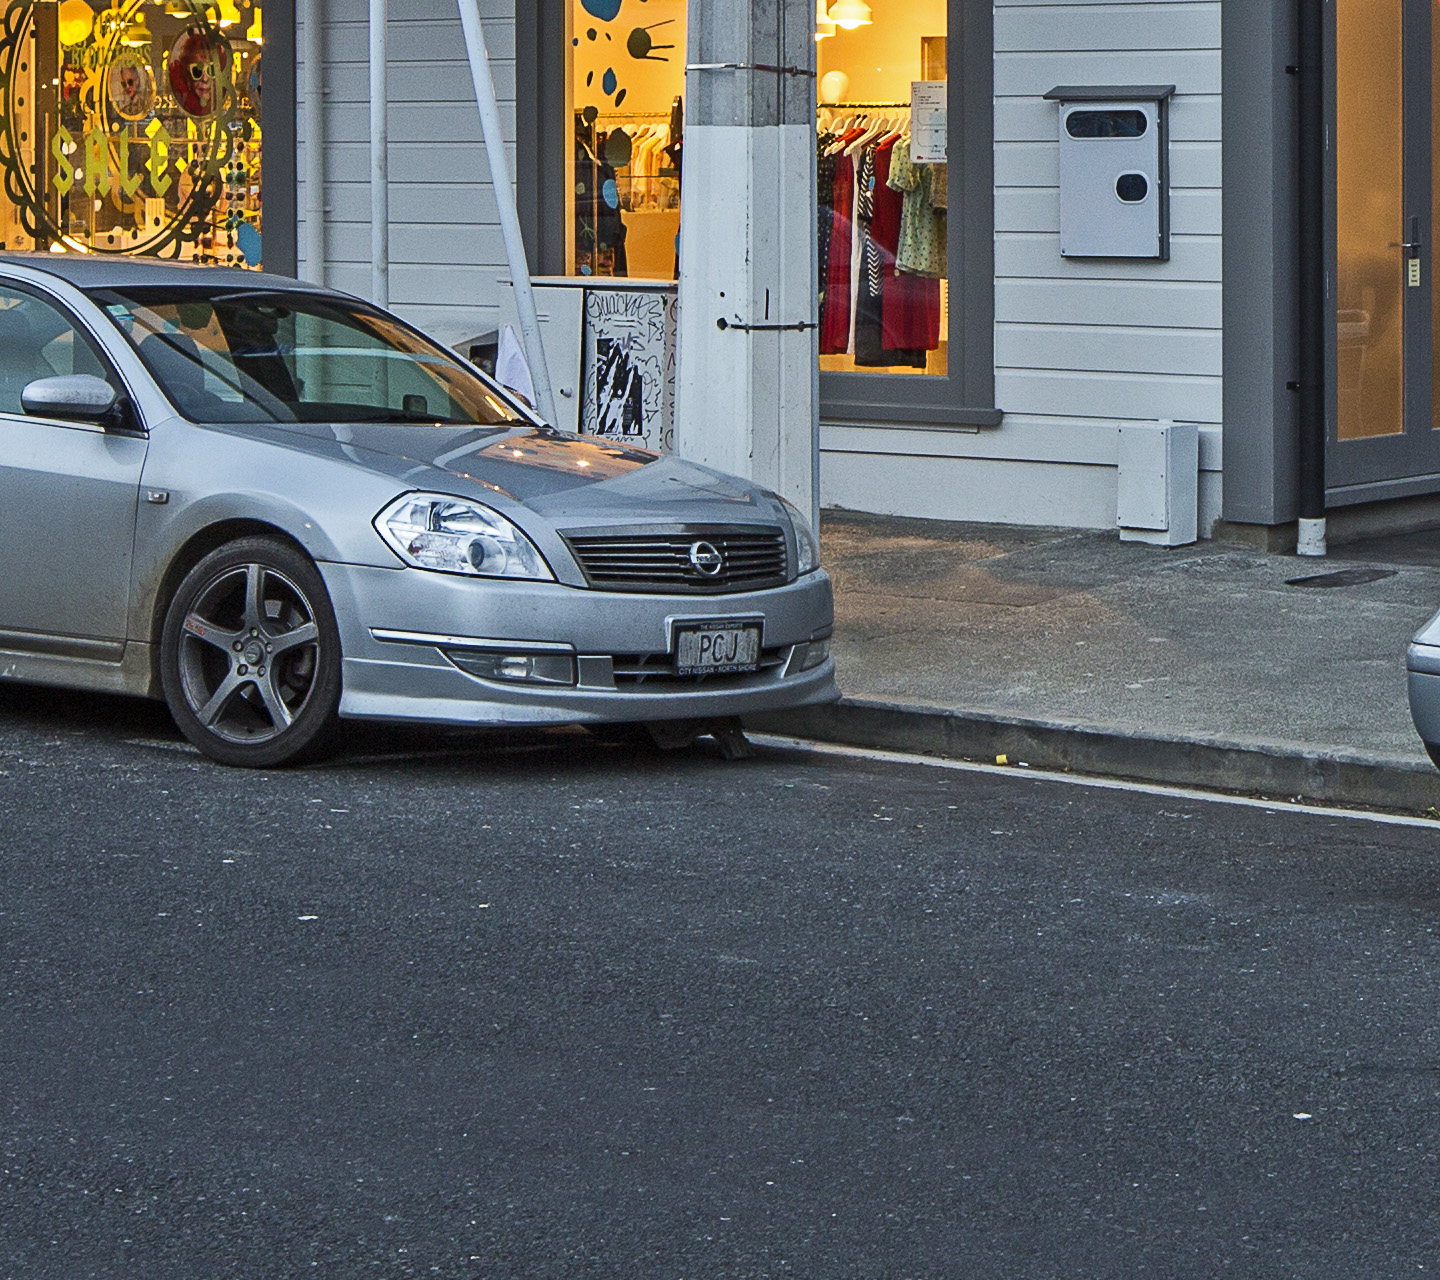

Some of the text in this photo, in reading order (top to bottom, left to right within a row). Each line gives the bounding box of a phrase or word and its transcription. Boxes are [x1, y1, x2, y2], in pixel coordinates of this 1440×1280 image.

[51, 124, 173, 198] SALE
[699, 632, 739, 664] PCJ
[678, 667, 693, 676] CITY
